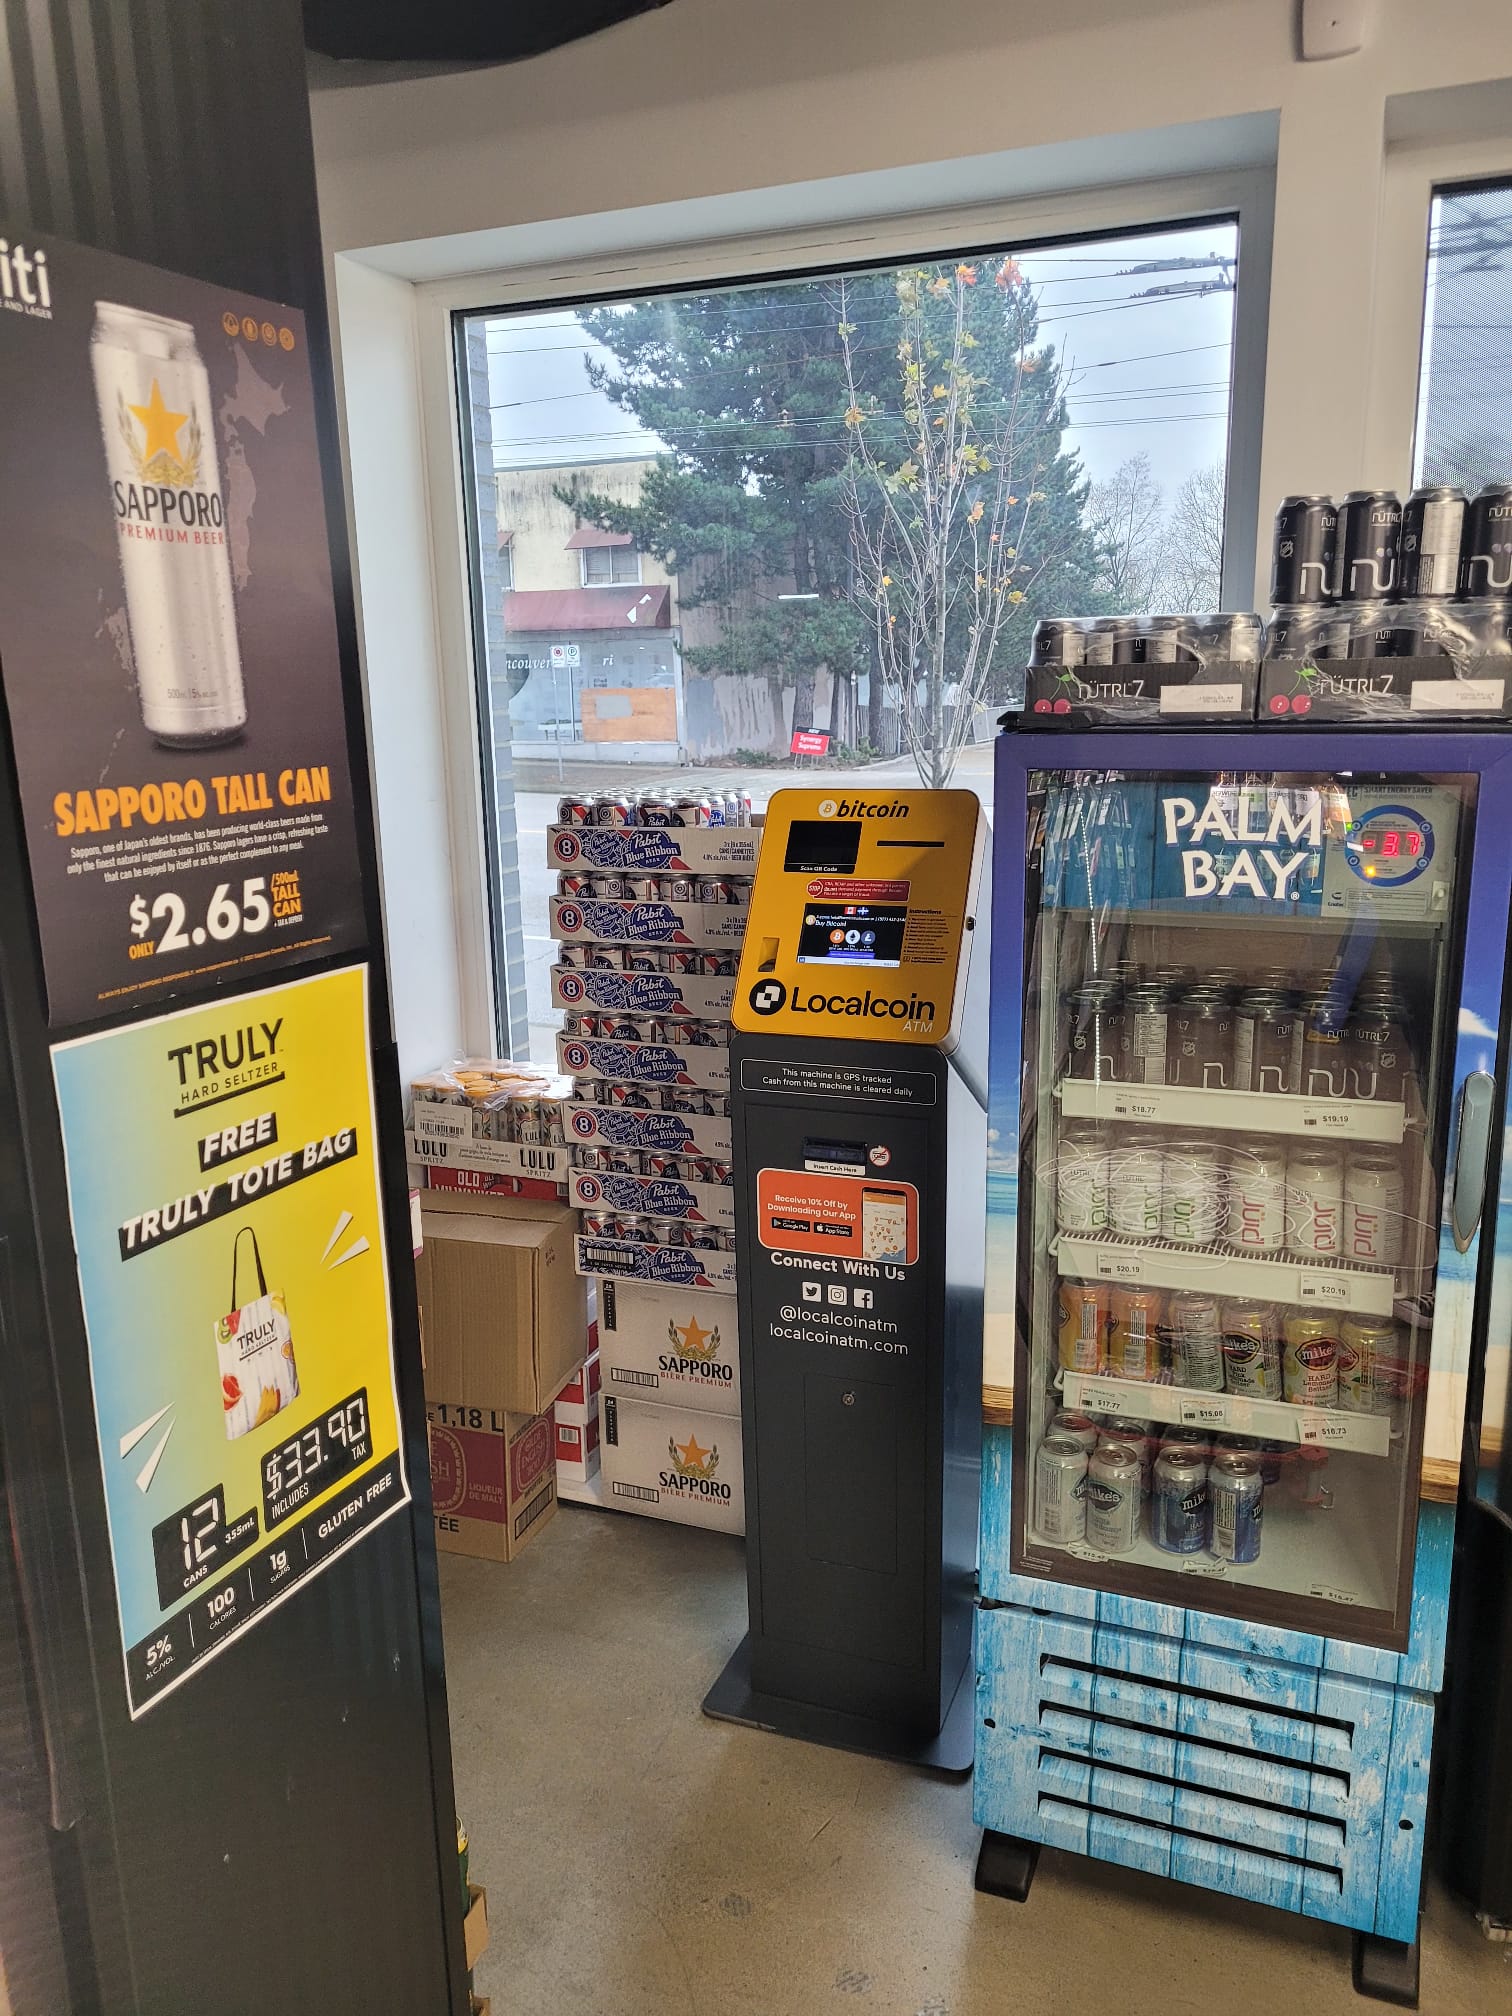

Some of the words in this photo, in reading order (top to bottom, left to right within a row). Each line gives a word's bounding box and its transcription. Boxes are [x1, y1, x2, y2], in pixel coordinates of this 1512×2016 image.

[114, 480, 223, 528] SAPPORO
[120, 523, 188, 544] PREMIUM
[194, 527, 224, 545] BEER
[54, 779, 207, 836] SAPPORO
[211, 772, 273, 815] TALL
[278, 766, 331, 806] CAN
[837, 800, 909, 818] bitcoin
[124, 838, 149, 851] Japan's
[149, 835, 169, 846] oldest
[194, 830, 206, 840] has
[206, 828, 221, 838] been
[222, 824, 249, 837] producing
[249, 819, 280, 831] world-class
[280, 817, 295, 826] beers
[296, 814, 310, 824] made
[1162, 797, 1322, 848] PALM
[67, 862, 82, 875] only
[82, 861, 95, 871] the
[96, 857, 116, 869] finest
[142, 848, 178, 862] ingredients
[178, 845, 195, 856] since
[195, 841, 213, 853] 1876.
[213, 839, 236, 852] Sapporo
[254, 834, 267, 843] have
[288, 827, 314, 838] refreshing
[563, 839, 571, 855] 8
[633, 833, 661, 848] Pabst
[103, 871, 120, 883] that
[120, 870, 133, 880] can
[143, 863, 167, 877] enjoyed
[167, 862, 176, 872] by
[176, 859, 192, 870] itself
[208, 855, 219, 865] the
[219, 851, 240, 864] perfect
[240, 846, 272, 859] complement
[272, 845, 279, 853] to
[279, 844, 289, 853] any
[626, 851, 645, 865] Blue
[645, 847, 679, 858] Ribbon
[1182, 849, 1309, 900] BAY
[272, 886, 301, 902] TALL
[129, 877, 270, 954] $2.65
[273, 899, 302, 917] CAN
[128, 941, 155, 960] ONLY
[569, 981, 576, 996] 8
[637, 979, 665, 992] Pabst
[628, 995, 648, 1007] Blue
[648, 991, 680, 1002] Ribbon
[790, 986, 936, 1021] Localcoin
[903, 1020, 934, 1033] ATM
[168, 1017, 284, 1085] TRULY
[181, 1080, 220, 1105] HARD
[224, 1062, 278, 1089] SELTZER
[782, 1068, 799, 1077] This
[800, 1069, 833, 1080] machine
[834, 1071, 842, 1080] is
[843, 1073, 860, 1082] GPS
[861, 1074, 892, 1084] tracked
[762, 1077, 782, 1086] Cash
[782, 1078, 802, 1087] from
[803, 1080, 818, 1088] this
[819, 1081, 852, 1091] machine
[854, 1083, 861, 1092] is
[862, 1085, 892, 1094] cleared
[893, 1087, 913, 1098] daily
[203, 1113, 275, 1164] FREE
[420, 1156, 444, 1164] SPRITZ
[520, 1149, 556, 1171] LULU
[122, 1184, 217, 1250] TRULY
[227, 1152, 293, 1202] TOTE
[302, 1128, 352, 1170] BAG
[458, 1171, 480, 1187] OLD
[767, 1203, 821, 1218] Downloading
[822, 1210, 838, 1218] Our
[839, 1211, 856, 1221] App
[775, 1194, 807, 1206] Receive
[807, 1198, 822, 1206] 10%
[823, 1199, 838, 1208] Off
[838, 1201, 848, 1211] by
[782, 1222, 799, 1231] Google
[660, 1251, 687, 1263] Pabst
[770, 1251, 838, 1273] Connect
[842, 1259, 880, 1278] With
[884, 1266, 906, 1281] Us
[652, 1263, 670, 1276] Blue
[671, 1264, 701, 1274] Ribbon
[1321, 1286, 1346, 1296] $20.19
[779, 1305, 898, 1334] @localcoinatm
[237, 1319, 275, 1350] TRULY
[770, 1323, 908, 1356] localcoinatm.com
[659, 1355, 733, 1381] SAPPORO
[1308, 1374, 1331, 1382] HARD
[661, 1371, 686, 1382] BIÈRE
[689, 1375, 731, 1388] PREMIUM
[1097, 1400, 1121, 1409] $17.77
[438, 1404, 482, 1429] 1,18
[491, 1411, 504, 1432] L
[266, 1397, 366, 1501] $33.90
[271, 1483, 309, 1519] INCLUDES
[351, 1445, 366, 1461] TAX
[469, 1482, 503, 1495] LIQUEUR
[659, 1471, 731, 1499] SAPPORO
[318, 1496, 363, 1538] GLUTEN
[366, 1473, 392, 1503] FREE
[481, 1493, 504, 1505] MALT
[661, 1487, 685, 1498] BIÈRE
[688, 1493, 730, 1507] PREMIUM
[181, 1498, 218, 1571] 12
[224, 1516, 255, 1544] 355mL
[269, 1550, 287, 1571] 1g
[183, 1565, 208, 1588] CANS
[270, 1565, 291, 1584] SUGARS
[207, 1587, 235, 1618] 100
[209, 1606, 237, 1630] CALORIES
[146, 1634, 172, 1666] 5%
